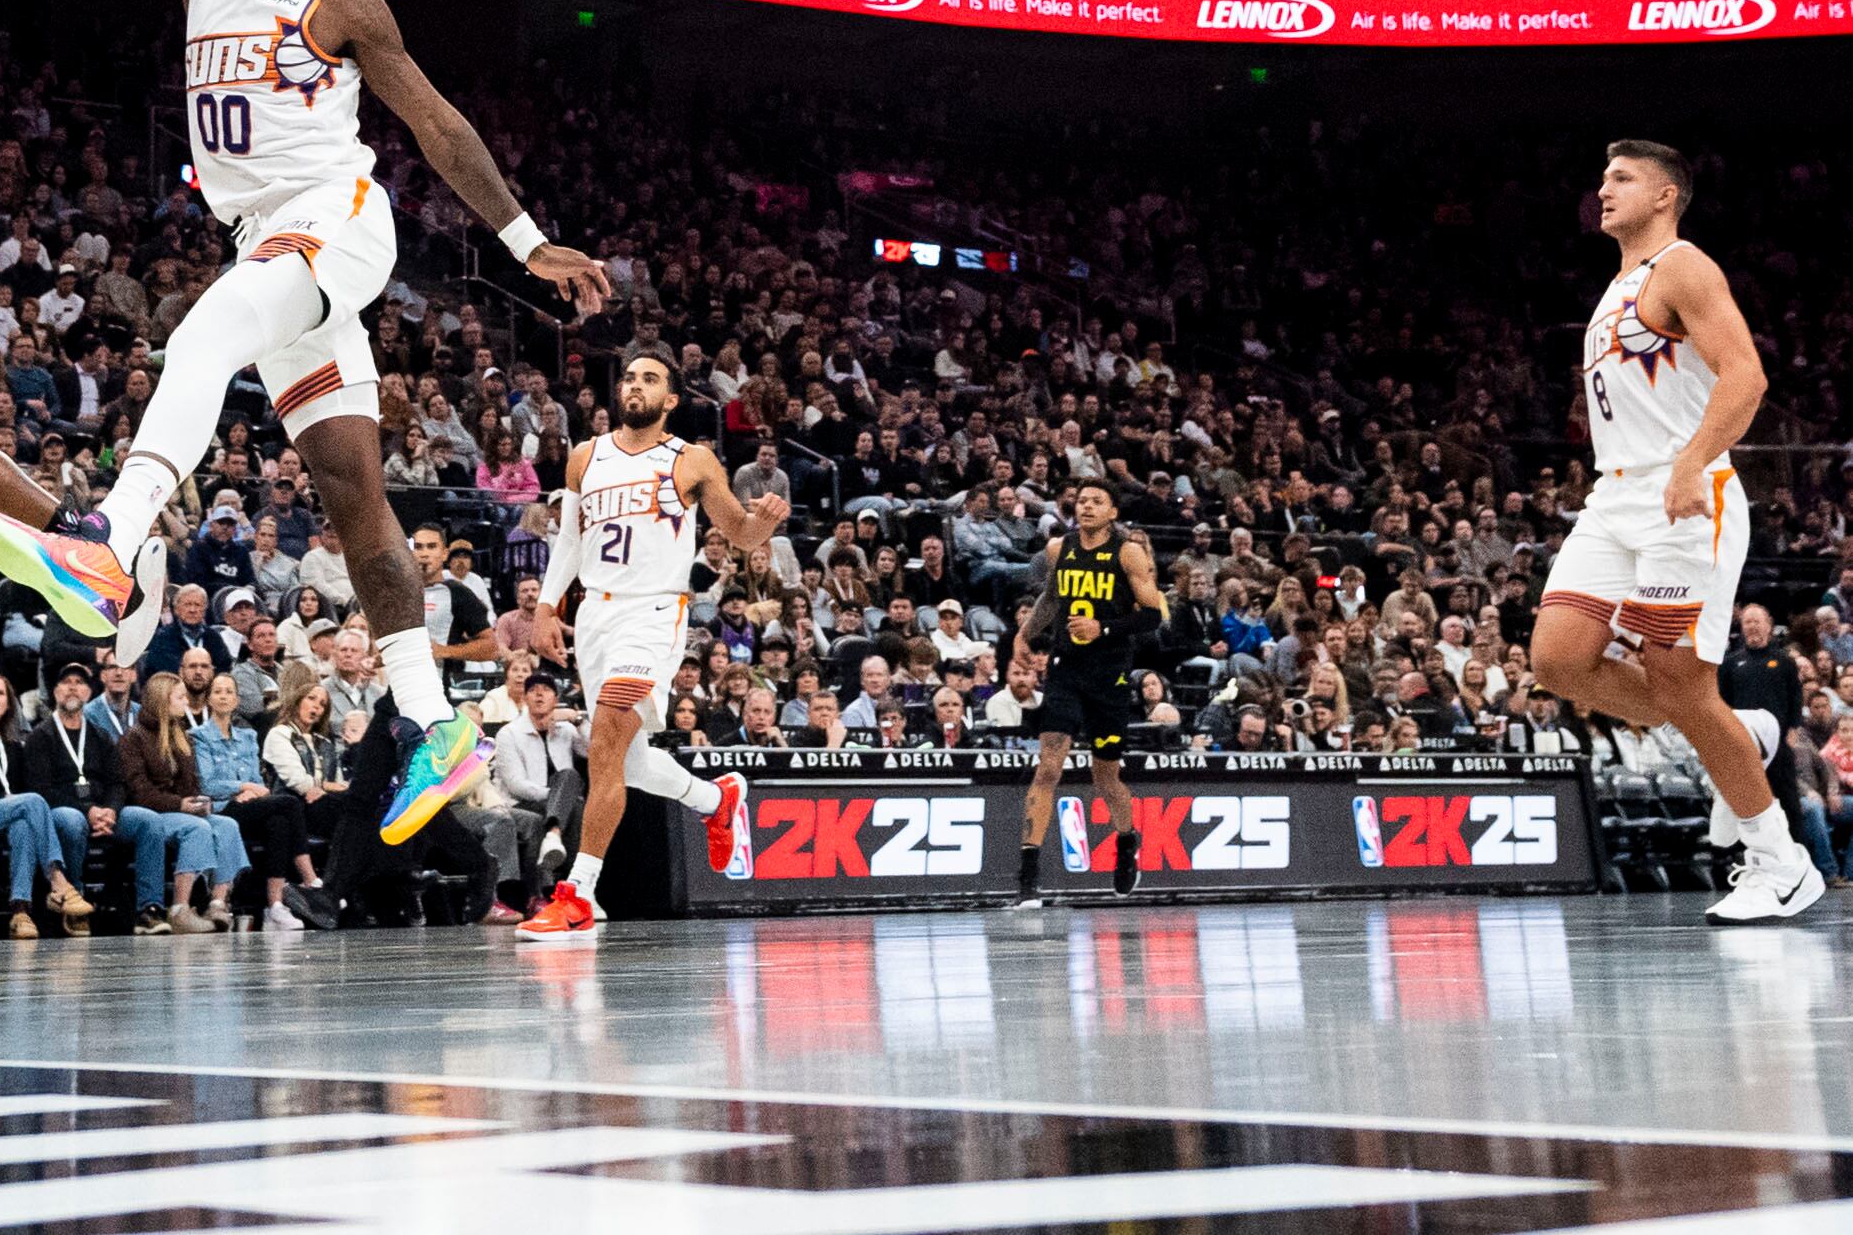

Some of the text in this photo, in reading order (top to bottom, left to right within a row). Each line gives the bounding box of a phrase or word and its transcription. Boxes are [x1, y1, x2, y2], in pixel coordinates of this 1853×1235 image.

[1078, 0, 1091, 19] it
[1096, 0, 1164, 24] perfect.
[1197, 0, 1308, 32] LENNOX
[1351, 10, 1375, 30] Air
[1382, 11, 1397, 31] is
[1401, 11, 1434, 32] life.
[1441, 11, 1492, 32] Make
[1498, 10, 1511, 31] it
[1518, 10, 1592, 34] perfect.
[196, 93, 252, 155] 00
[1592, 370, 1613, 422] 8
[581, 481, 653, 526] SUNS
[600, 523, 633, 565] 21
[1057, 569, 1115, 600] UTAH
[709, 751, 1574, 772] DELTA DELTA DELTA DELTA DELTA DELTA DELTA DELTA DELTA DELTA
[753, 797, 985, 880] 2K25
[1090, 796, 1290, 872] 2K25
[1382, 796, 1557, 867] 2K25
